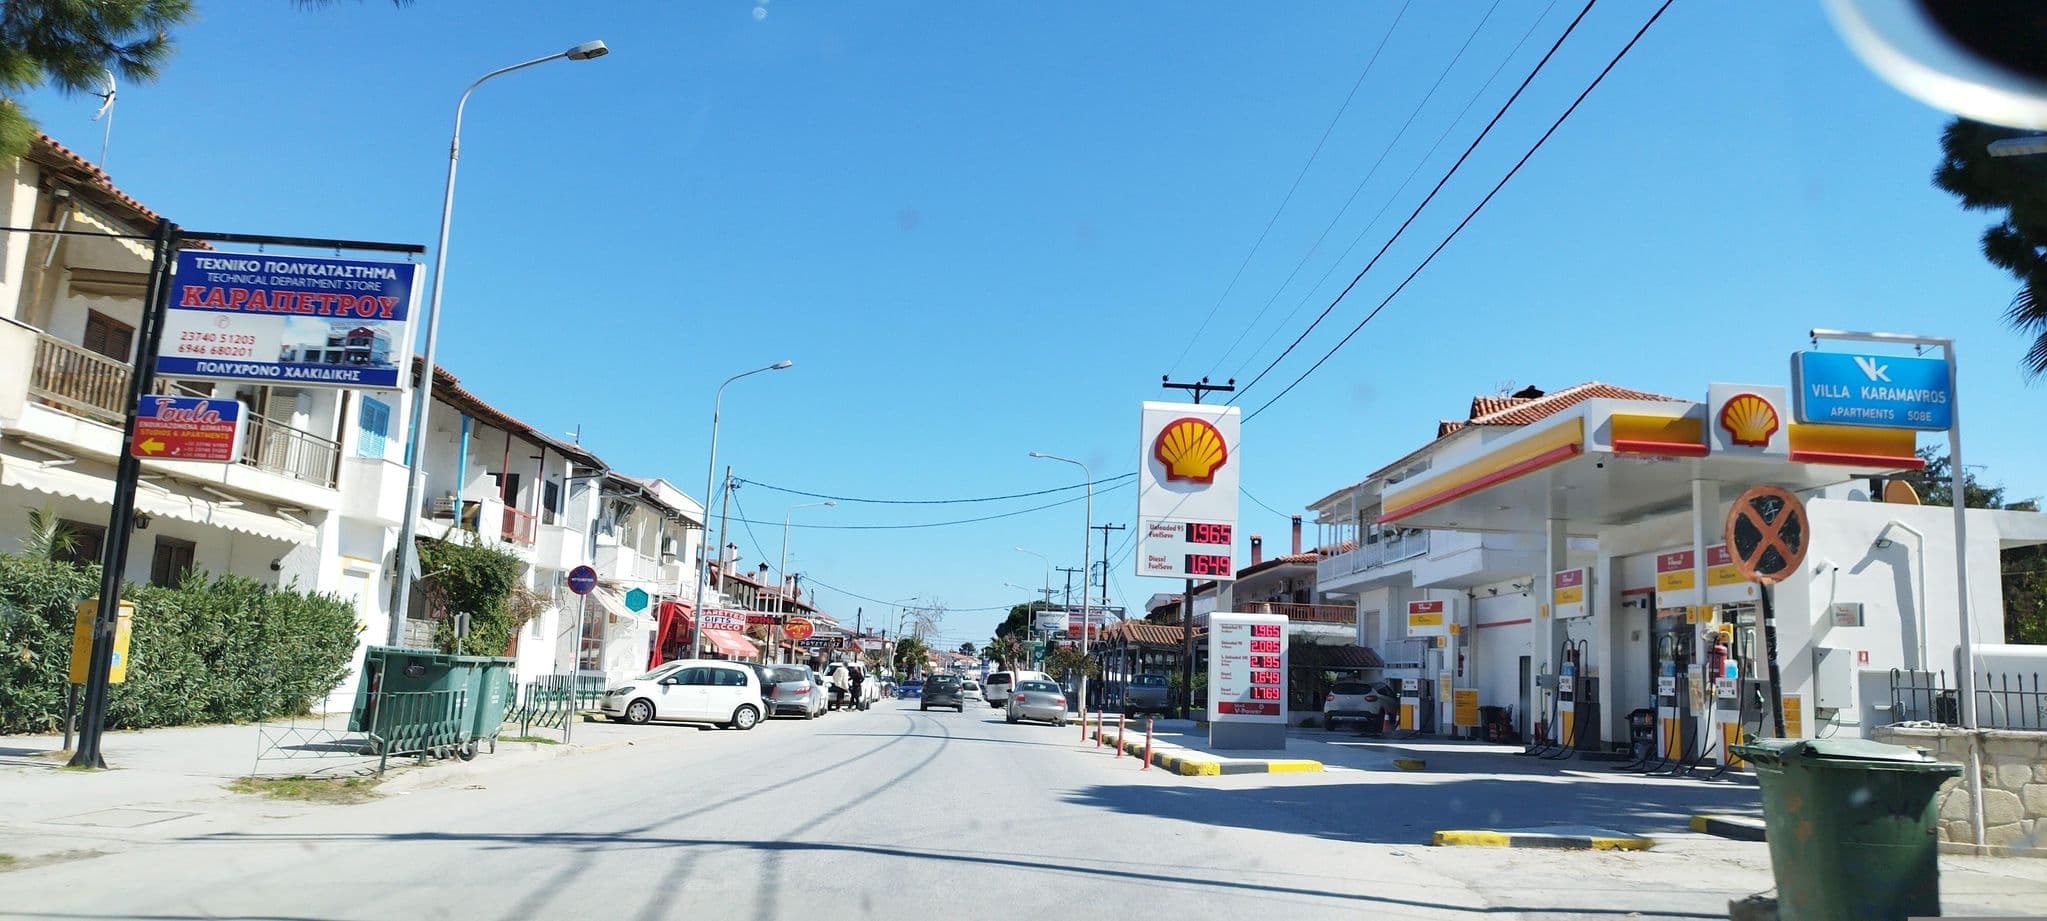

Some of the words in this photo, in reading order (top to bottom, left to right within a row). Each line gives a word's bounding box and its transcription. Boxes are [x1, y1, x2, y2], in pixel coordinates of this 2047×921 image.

[195, 257, 261, 272] ΤΕΧΝΙΚΟ
[264, 261, 397, 280] ΠΟΛΥΚΑΤΑΣΤΗΜΑ
[207, 272, 268, 285] TECHNICAL
[270, 275, 343, 289] DEPARTMENT
[344, 280, 382, 292] STORE
[180, 285, 399, 318] ΚΑΡΑΠΕΤΡΟΥ
[181, 331, 217, 342] 23740
[178, 344, 206, 354] 6946
[196, 361, 280, 376] ΠΟΛΥΧΡΟΝΟ
[284, 366, 361, 381] ΧΑΛΚΙΔΙΚΗΣ
[1812, 383, 1850, 398] VILLA
[1861, 386, 1946, 404] KARAMAVROS
[155, 398, 221, 424] Toula
[1830, 406, 1894, 420] APARTMENTS
[1907, 410, 1932, 422] SOBE
[1192, 524, 1231, 544] 1.965
[1191, 555, 1229, 576] 1.649
[701, 623, 741, 631] OBACCO
[705, 616, 731, 624] GIFTS
